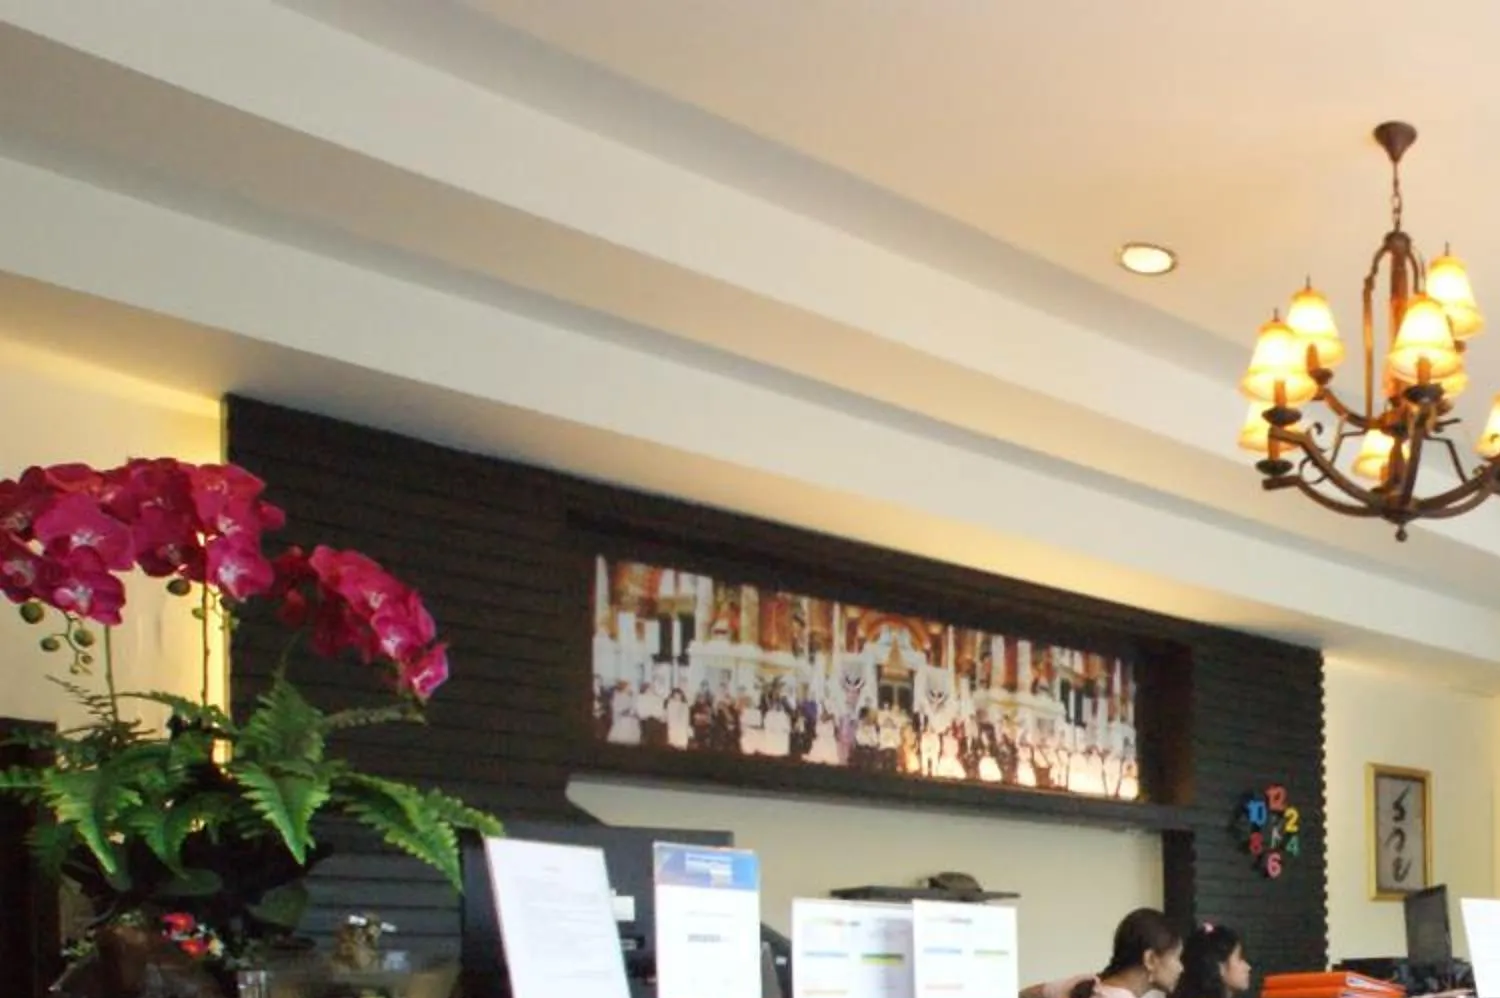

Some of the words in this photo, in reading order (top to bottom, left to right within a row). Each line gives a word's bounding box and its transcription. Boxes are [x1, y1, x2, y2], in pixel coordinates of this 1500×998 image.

[1246, 799, 1268, 828] 10
[1284, 806, 1299, 832] 2
[1286, 836, 1299, 857] 4
[1267, 852, 1282, 878] 6
